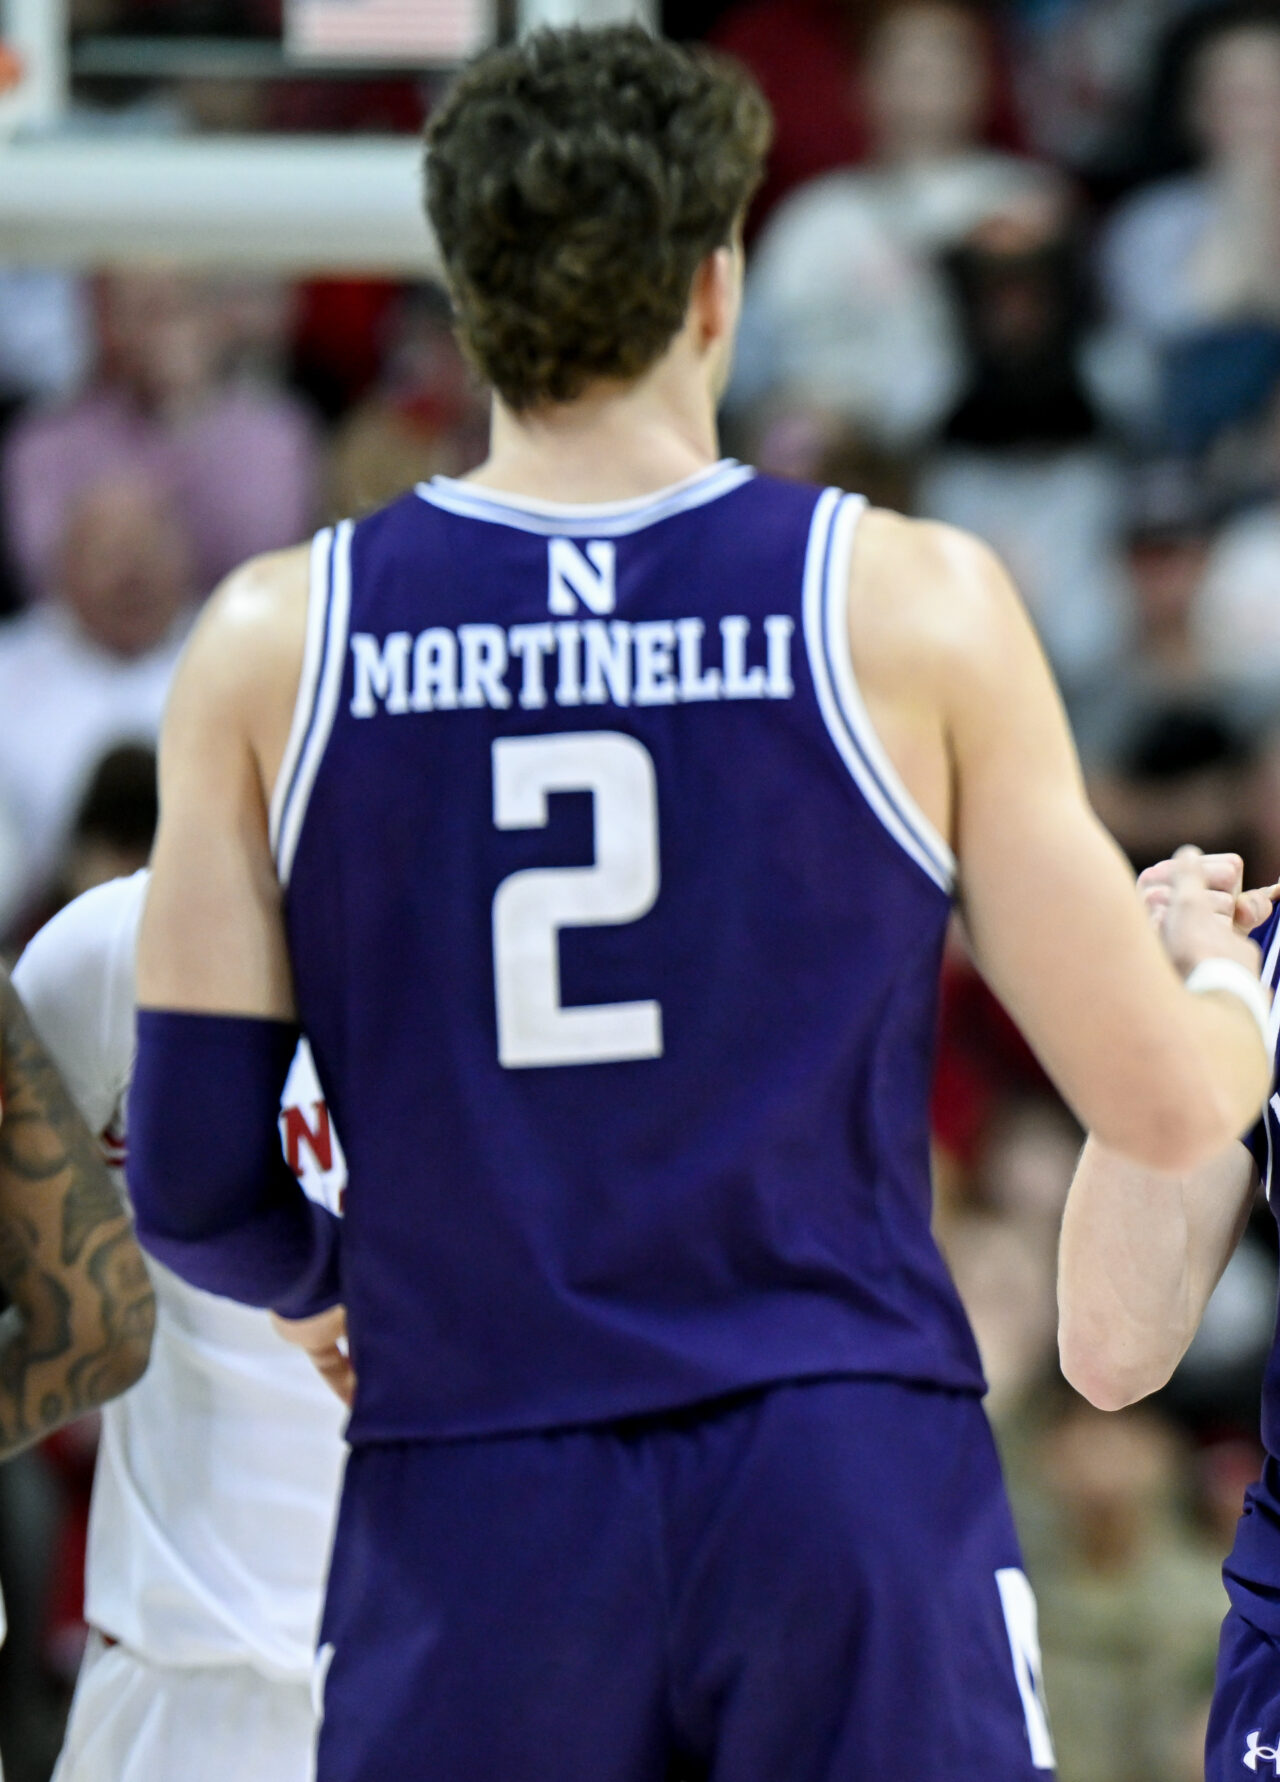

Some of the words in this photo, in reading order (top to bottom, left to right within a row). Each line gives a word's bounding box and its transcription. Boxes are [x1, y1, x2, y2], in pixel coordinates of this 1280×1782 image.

[548, 537, 615, 615] N
[350, 615, 794, 718] MARTINELLI
[491, 731, 662, 1068] 2
